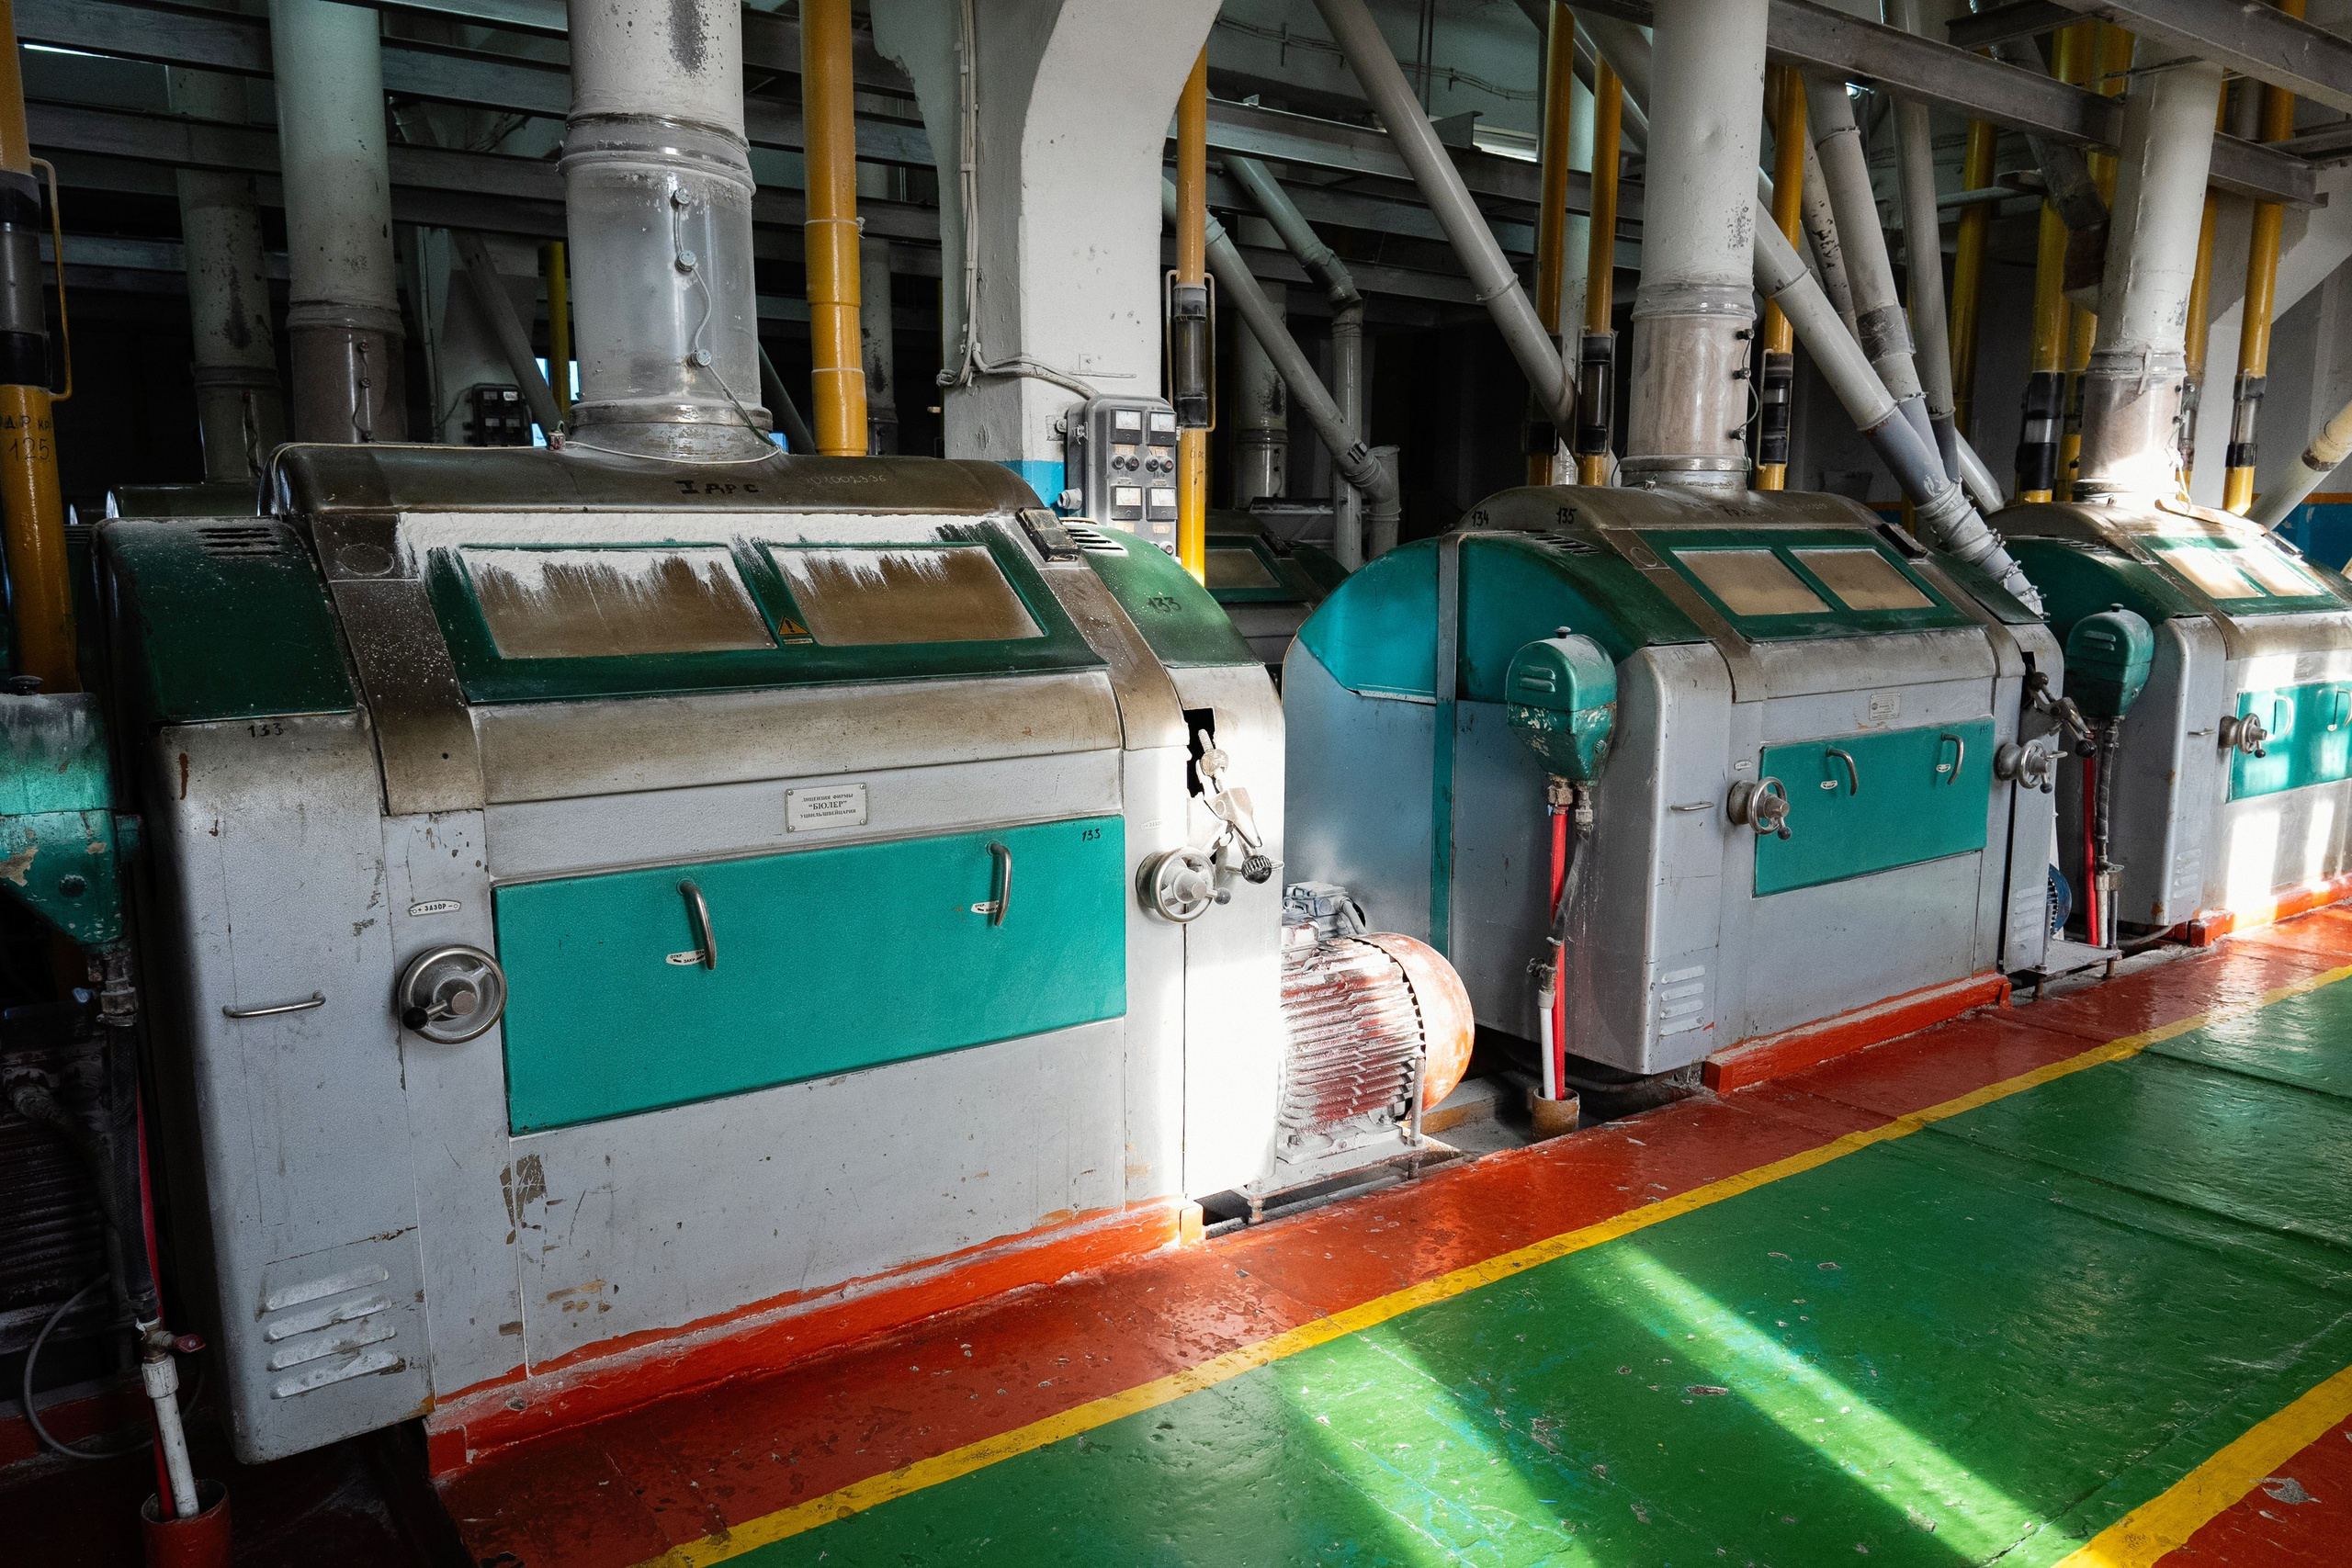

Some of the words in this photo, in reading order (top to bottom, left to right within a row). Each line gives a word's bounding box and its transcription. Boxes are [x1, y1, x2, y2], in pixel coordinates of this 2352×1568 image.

[1472, 510, 1489, 527] 134
[1556, 507, 1577, 525] 135
[1148, 596, 1182, 614] 133
[247, 722, 284, 738] 133
[1081, 828, 1101, 842] 133
[424, 903, 447, 912] ЗАЗОР
